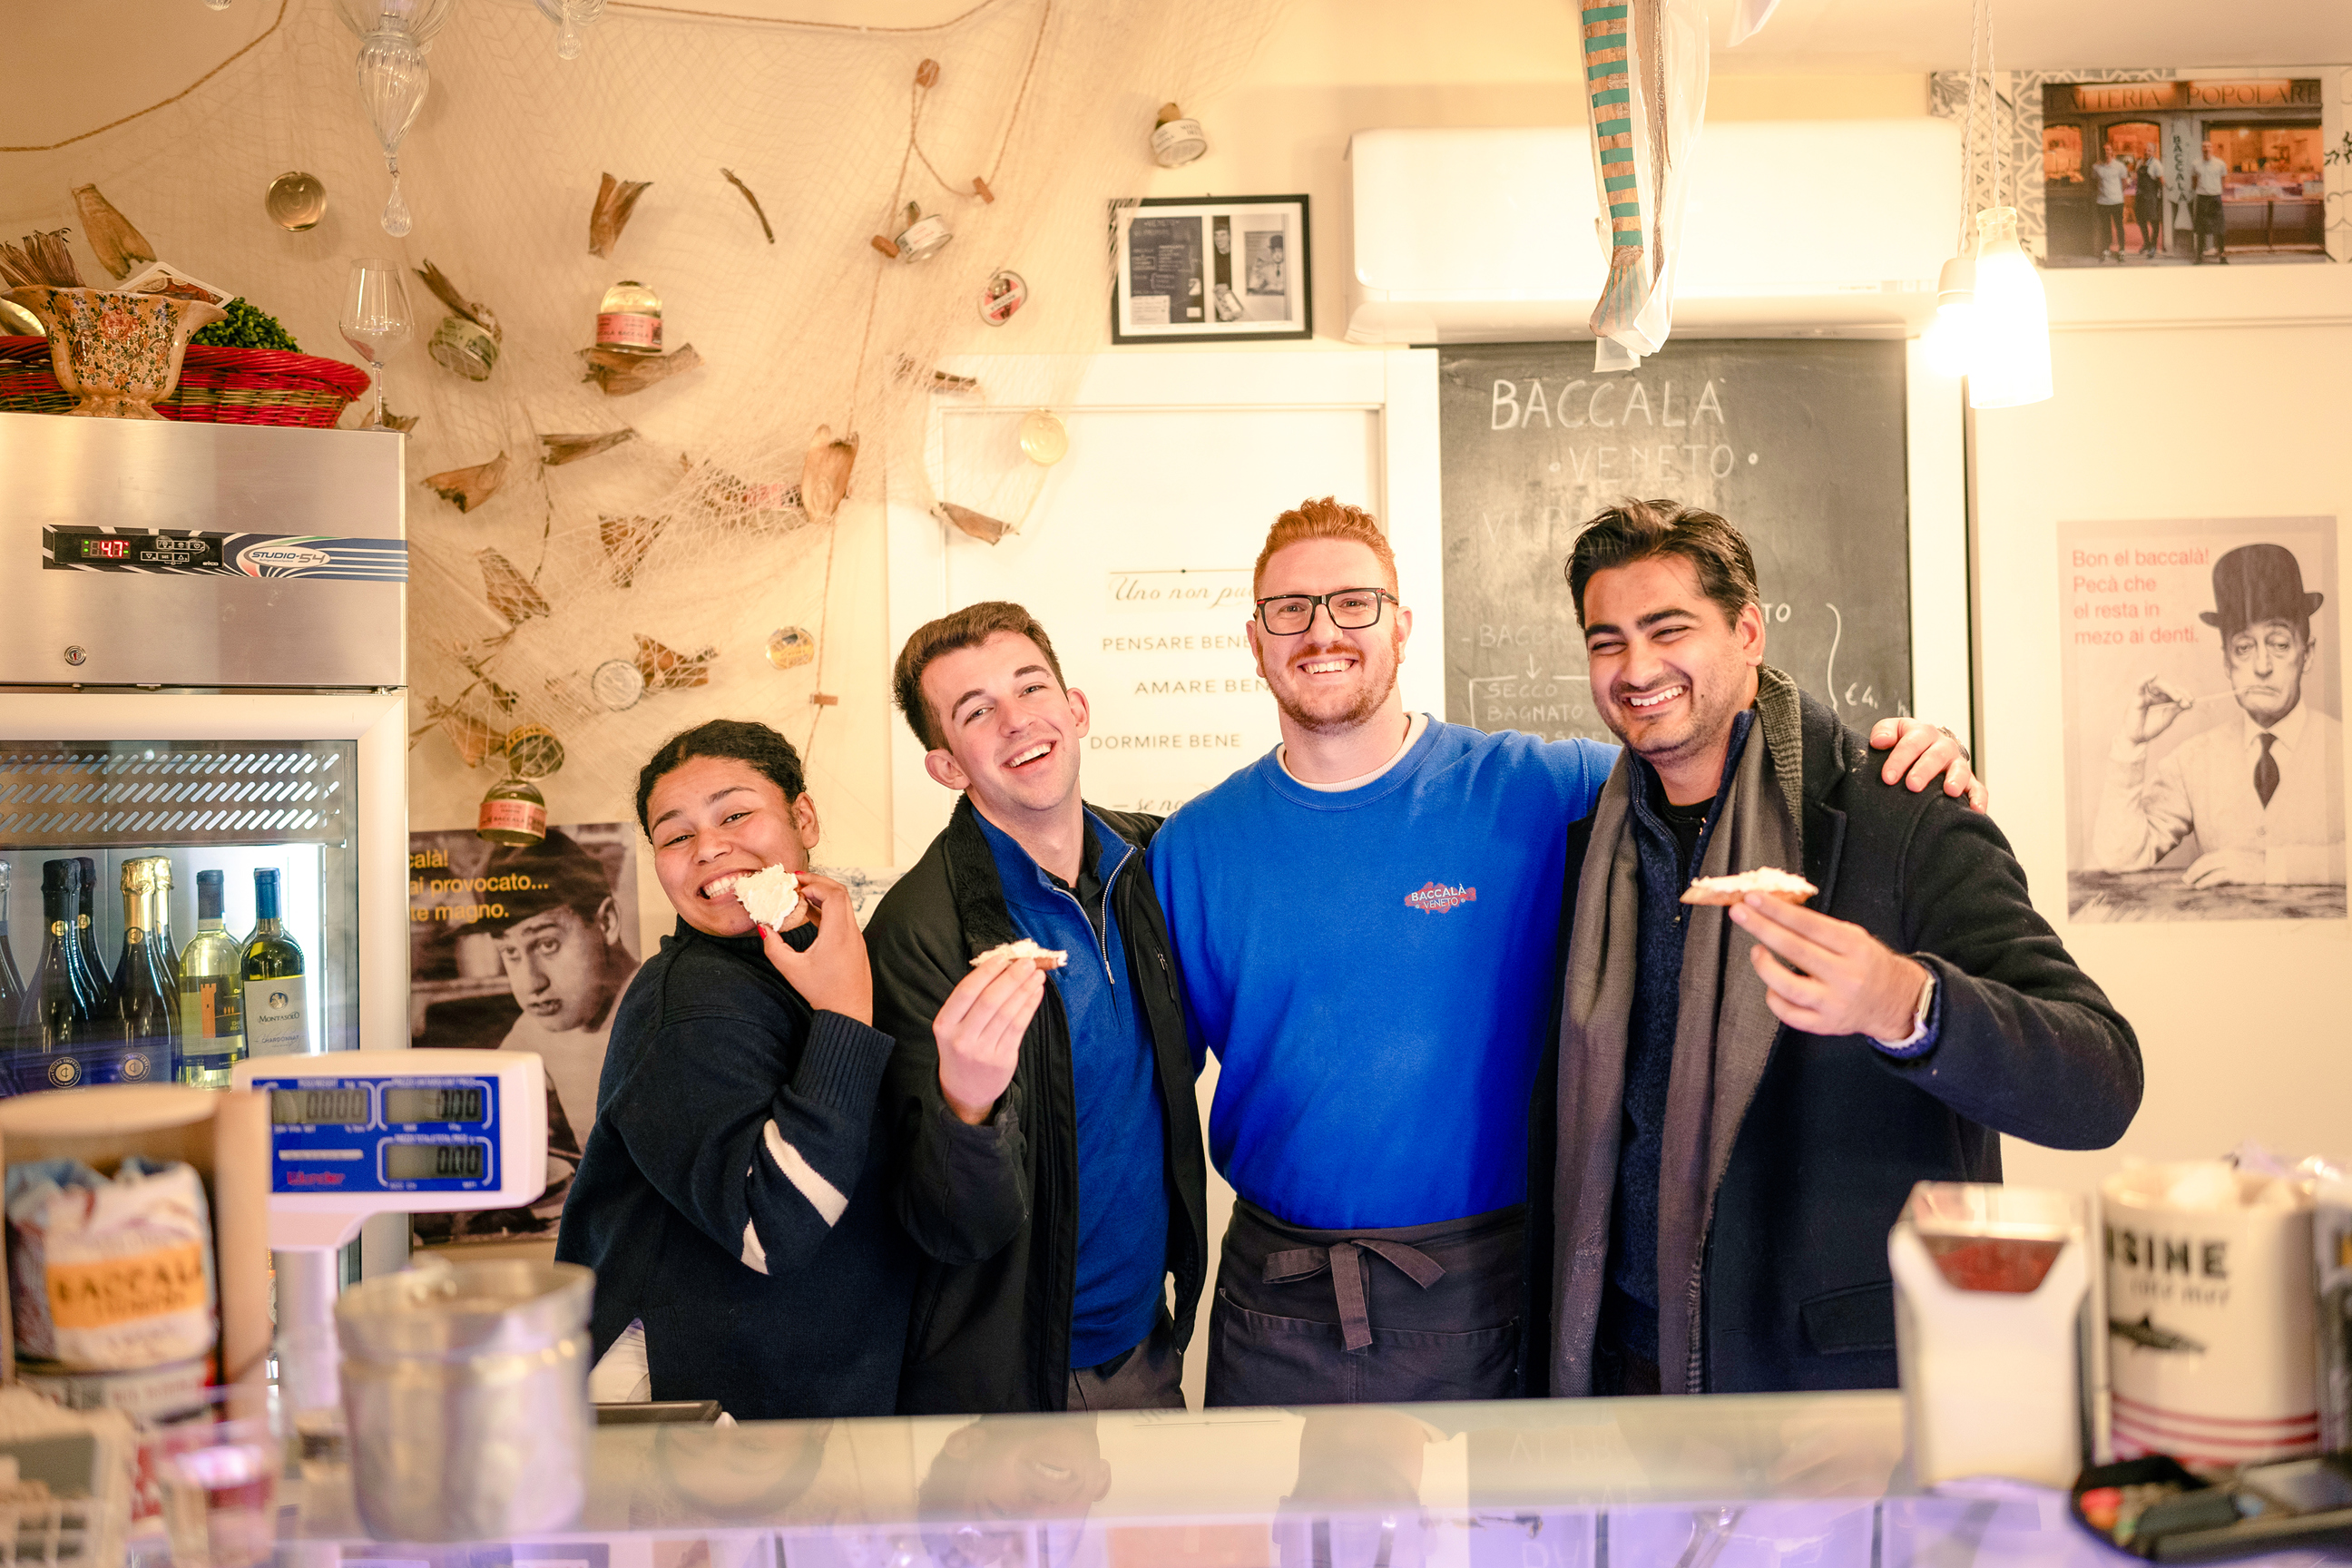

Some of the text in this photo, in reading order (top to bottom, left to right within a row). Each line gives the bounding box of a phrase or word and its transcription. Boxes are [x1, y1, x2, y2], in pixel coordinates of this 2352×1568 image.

[2186, 83, 2320, 105] POPOLARE
[1570, 444, 1735, 484] VENETO
[2073, 547, 2210, 567] Bon el baccalà!
[1109, 575, 1161, 601] Uno
[1169, 587, 1210, 600] non
[2073, 573, 2157, 593] Pecà che
[1760, 602, 1792, 624] TO
[2073, 601, 2160, 620] el resta in
[1102, 636, 1194, 651] PENSARE
[2074, 624, 2199, 645] mezo ai denti.
[1134, 679, 1269, 694] AMARE BEN
[1485, 681, 1558, 699] SECCO
[1487, 703, 1584, 722] BAGNATO
[1090, 733, 1241, 750] DORMIRE BENE
[1136, 798, 1185, 812] se no
[430, 873, 549, 897] provocato...
[1411, 883, 1467, 901] BACCALÀ
[1424, 897, 1459, 909] VENETO
[410, 903, 510, 924] te magno.
[261, 1034, 300, 1044] CHARDONNAY
[2104, 1225, 2228, 1279] ISINE
